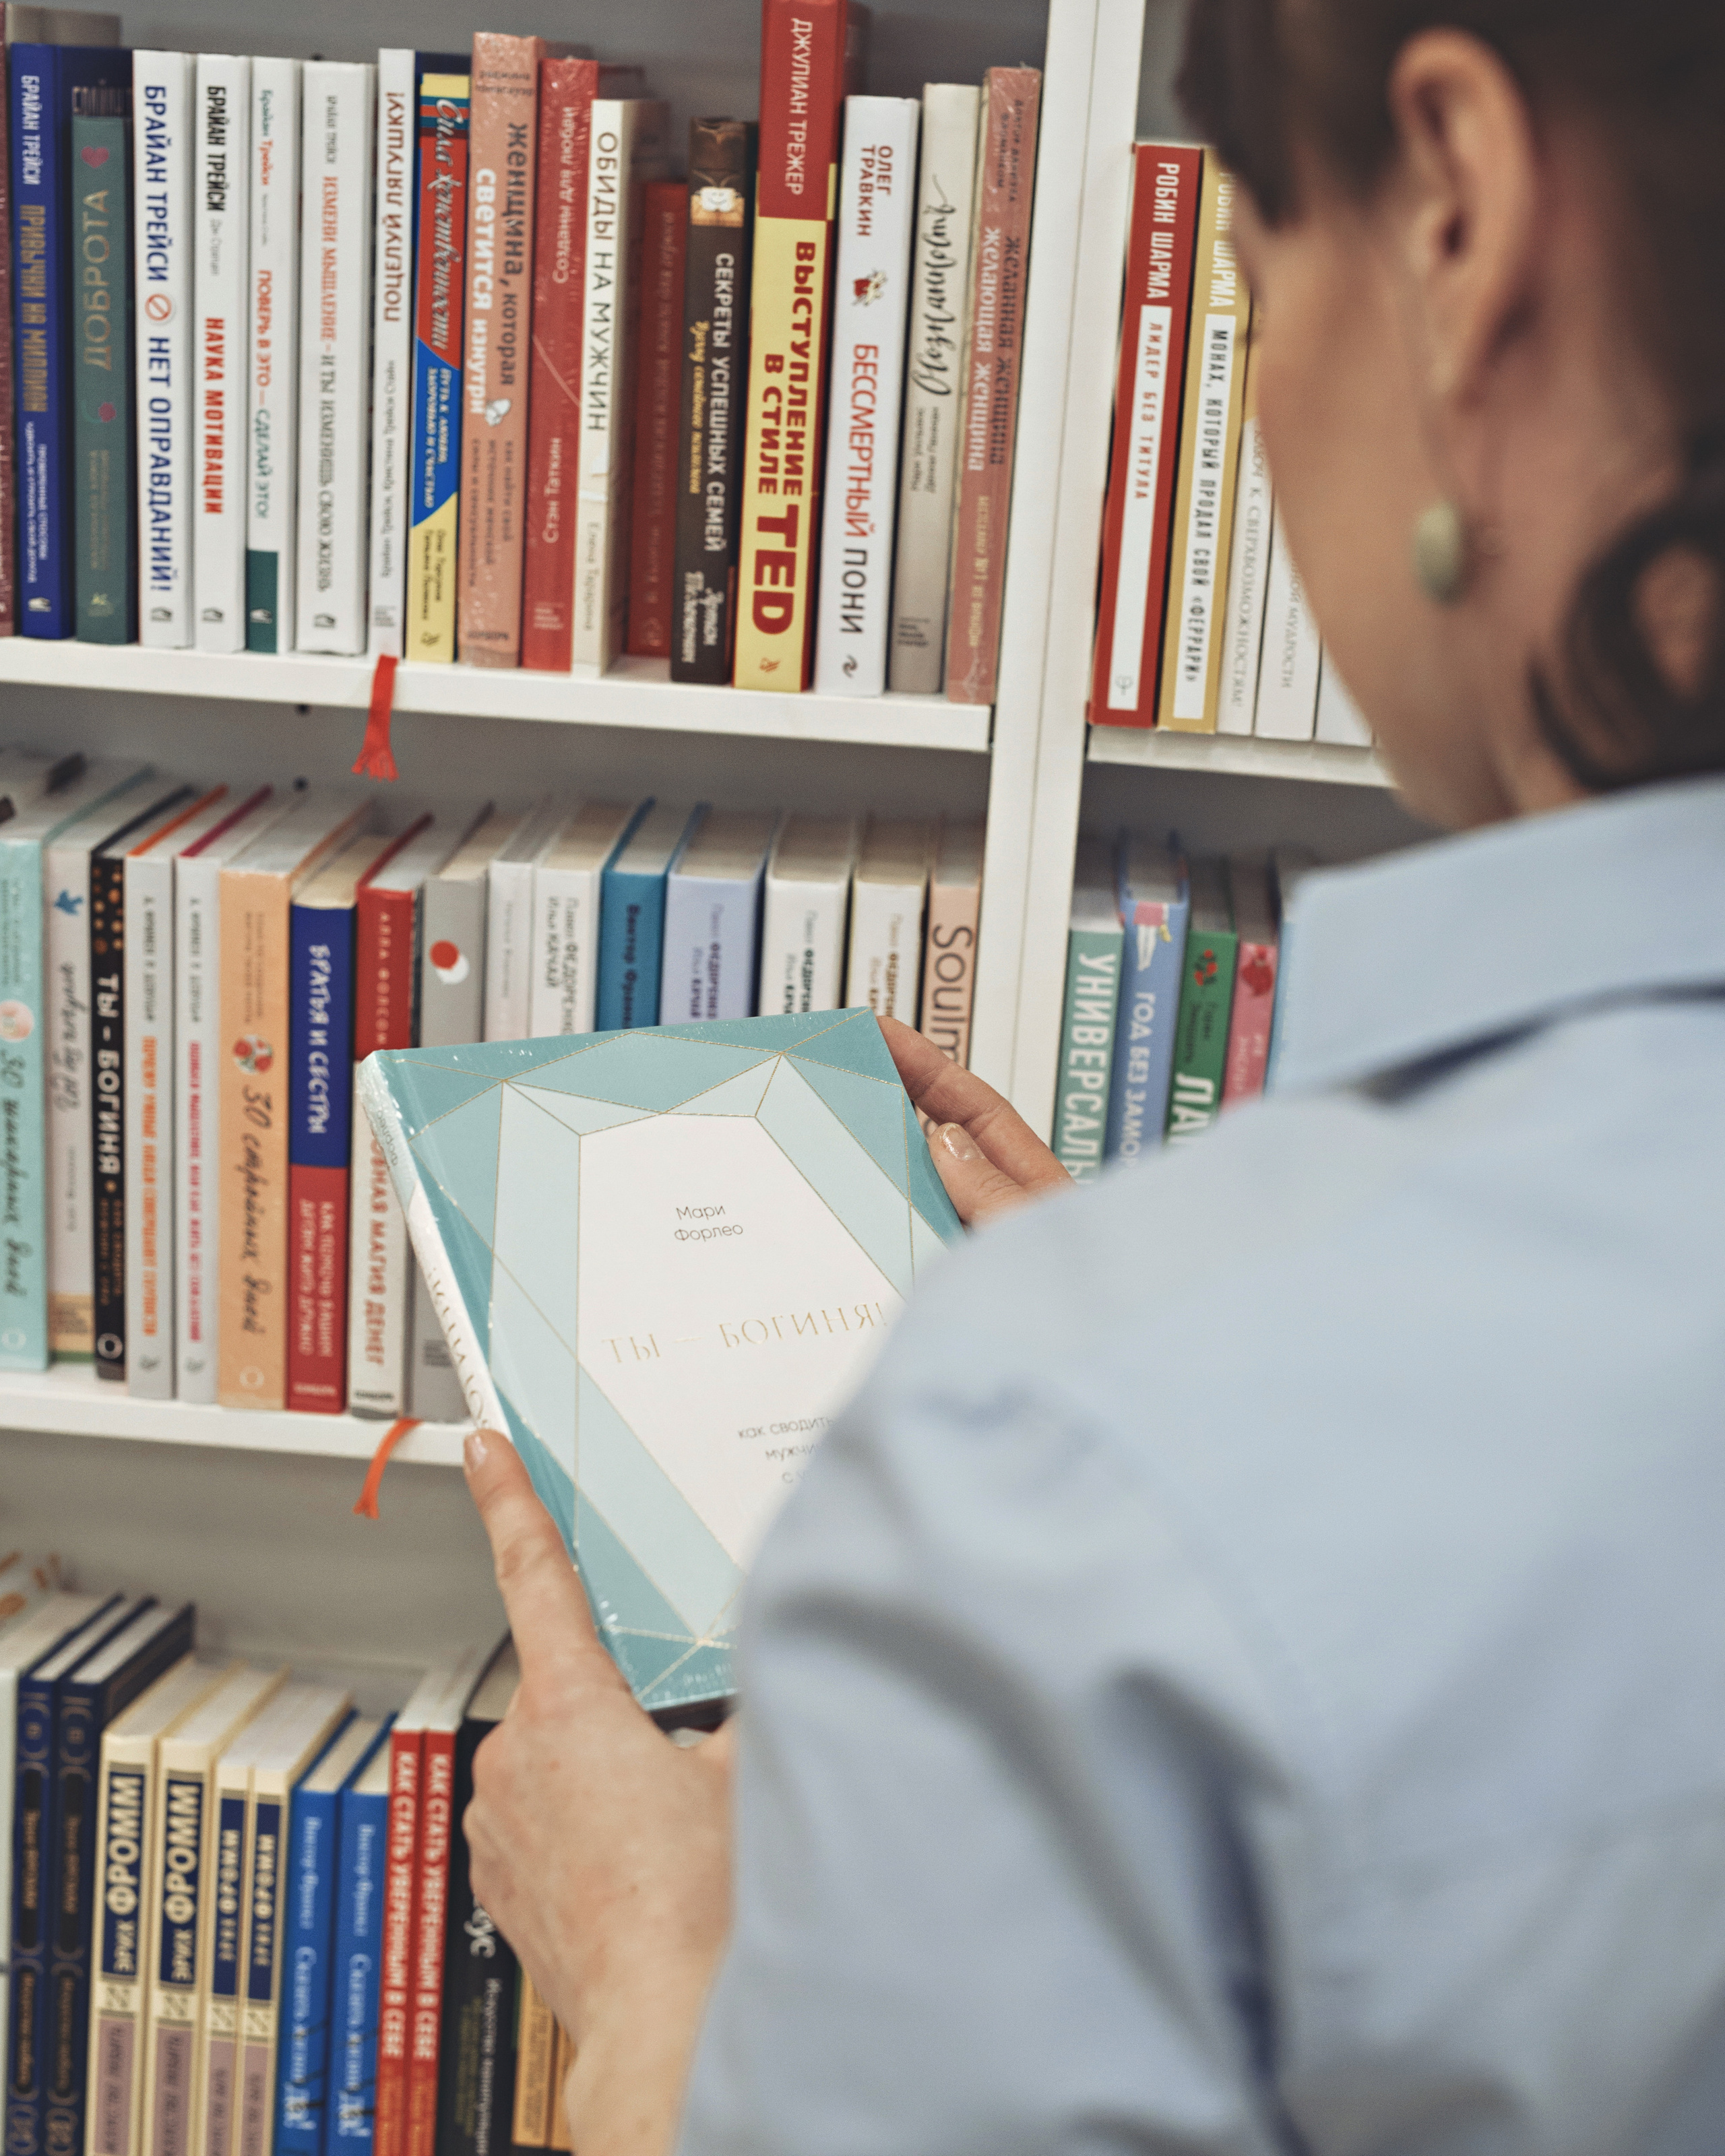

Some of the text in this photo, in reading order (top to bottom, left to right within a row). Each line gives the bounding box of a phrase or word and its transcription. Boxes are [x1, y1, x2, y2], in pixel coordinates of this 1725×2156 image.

[22, 75, 43, 185] БРАЙАН ТРЕЙСИ
[206, 86, 230, 145] БРАЙАН
[435, 99, 464, 166] Сила
[785, 18, 813, 195] ДЖУЛИАН ТРЕЖЕР
[145, 85, 172, 282] БРАЙАН ТРЕЙСИ
[206, 153, 230, 212] ТРЕЙСИ
[257, 140, 274, 185] Трейси
[558, 169, 574, 202] для
[856, 145, 876, 236] ТРАВКИН
[876, 146, 893, 196] ОЛЕГ
[321, 176, 339, 241] ИЗМЕНИ
[382, 91, 404, 321] ПОЦЕЛУЙ ЛЯГУШКУ!
[499, 121, 528, 286] женщина,
[1146, 162, 1180, 298] РОБИН ШАРМА
[20, 205, 46, 297] ПРИВЫЧКИ
[82, 190, 111, 371] ДОБРОТА
[552, 205, 572, 283] Созданы
[587, 132, 618, 430] ОБИДЫ НА МУЖЧИН
[1209, 240, 1236, 307] ШАРМА
[22, 303, 46, 323] НА
[257, 270, 271, 334] ПОВЕРЬ
[467, 168, 497, 414] светится изнутри
[976, 226, 1001, 352] желающая
[257, 354, 271, 387] ЭТО
[497, 293, 519, 385] которая
[783, 242, 815, 496] ВЫСТУПЛЕНИЕ
[989, 235, 1021, 465] желанная женщина
[202, 318, 224, 514] НАУКА МОТИВАЦИИ
[704, 253, 734, 551] СЕКРЕТЫ УСПЕШНЫХ СЕМЕЙ
[758, 354, 784, 494] В СТИЛЕ
[968, 362, 992, 471] женщина
[1134, 323, 1163, 499] ЛИДЕР БЕЗ ТИТУЛА
[148, 337, 178, 591] НЕТ ОПРАВДАНИЙ!
[255, 409, 273, 476] СДЕЛАЙ
[840, 344, 879, 633] БЕССМЕРТНЫЙ ПОНИ
[1185, 329, 1228, 682] МОНАХ, КОТОРЫЙ ПРОДАЛ СВОЙ «ФЕРРАРИ»
[752, 504, 799, 635] TED
[378, 912, 391, 959] АЛЛА
[96, 974, 119, 1017] ТЫ
[931, 924, 973, 1065] Soulm
[308, 945, 332, 1134] БРАТЬЯ И СЕСТРЫ
[1061, 953, 1117, 1184] УНИВЕРСАЛЬ
[97, 1050, 120, 1174] БОГИНЯ
[242, 1085, 273, 1129] 30
[1120, 992, 1156, 1168] ГОД БЕЗ ЗАМО
[1169, 1073, 1214, 1145] ЛА
[375, 1110, 399, 1166] Форлео
[674, 1224, 743, 1242] Форлео
[676, 1205, 725, 1222] Мари
[367, 1219, 387, 1295] МАГИЯ
[601, 1333, 661, 1363] ТЫ
[738, 1426, 765, 1440] как
[765, 1443, 815, 1461] мужчи
[396, 1752, 418, 1793] КАК
[429, 1753, 451, 1796] КАК
[107, 1776, 141, 1914] ФРОММ
[164, 1785, 199, 1924] ФРОММ
[391, 1795, 415, 1862] СТАТЬ
[423, 1797, 449, 1862] СТАТЬ
[382, 2008, 406, 2060] СЕБЕ
[385, 1990, 406, 2006] В
[413, 2010, 438, 2060] СЕБЕ
[416, 1992, 439, 2008] В
